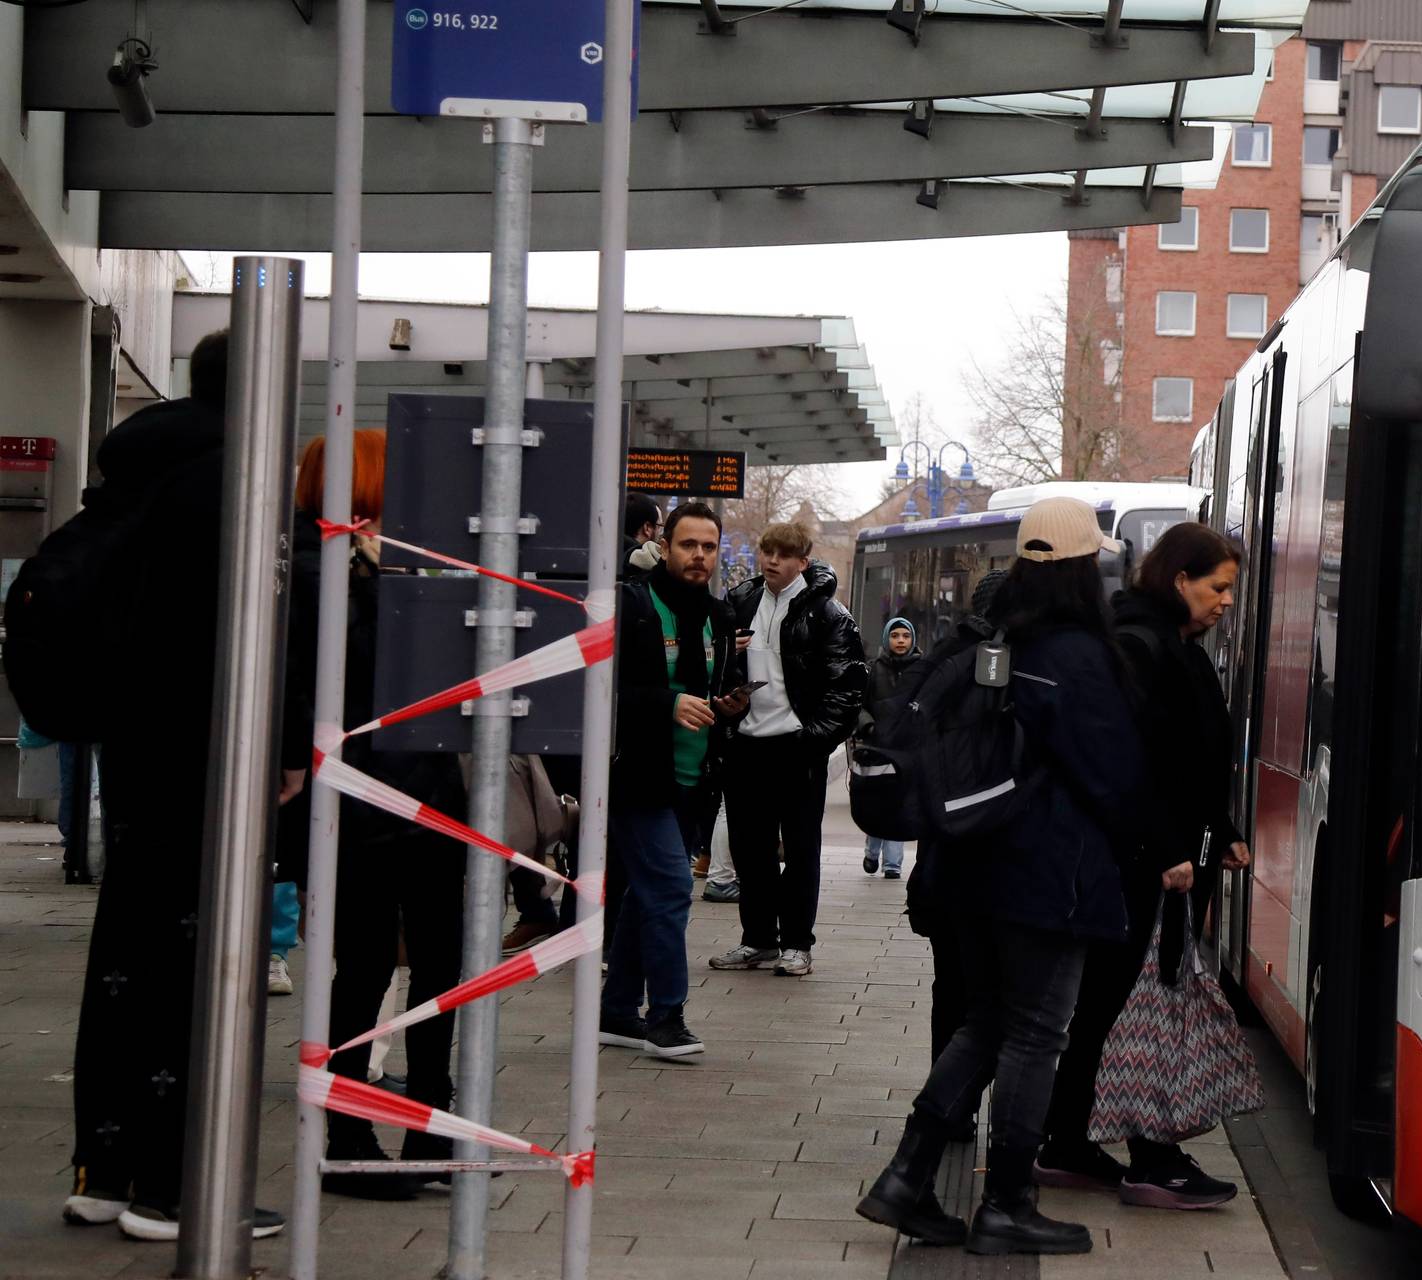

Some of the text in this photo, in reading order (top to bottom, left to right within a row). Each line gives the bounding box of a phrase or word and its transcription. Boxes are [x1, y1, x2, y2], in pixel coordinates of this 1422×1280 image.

[409, 14, 424, 23] Bus
[433, 13, 498, 30] 916, 922
[22, 438, 37, 456] T
